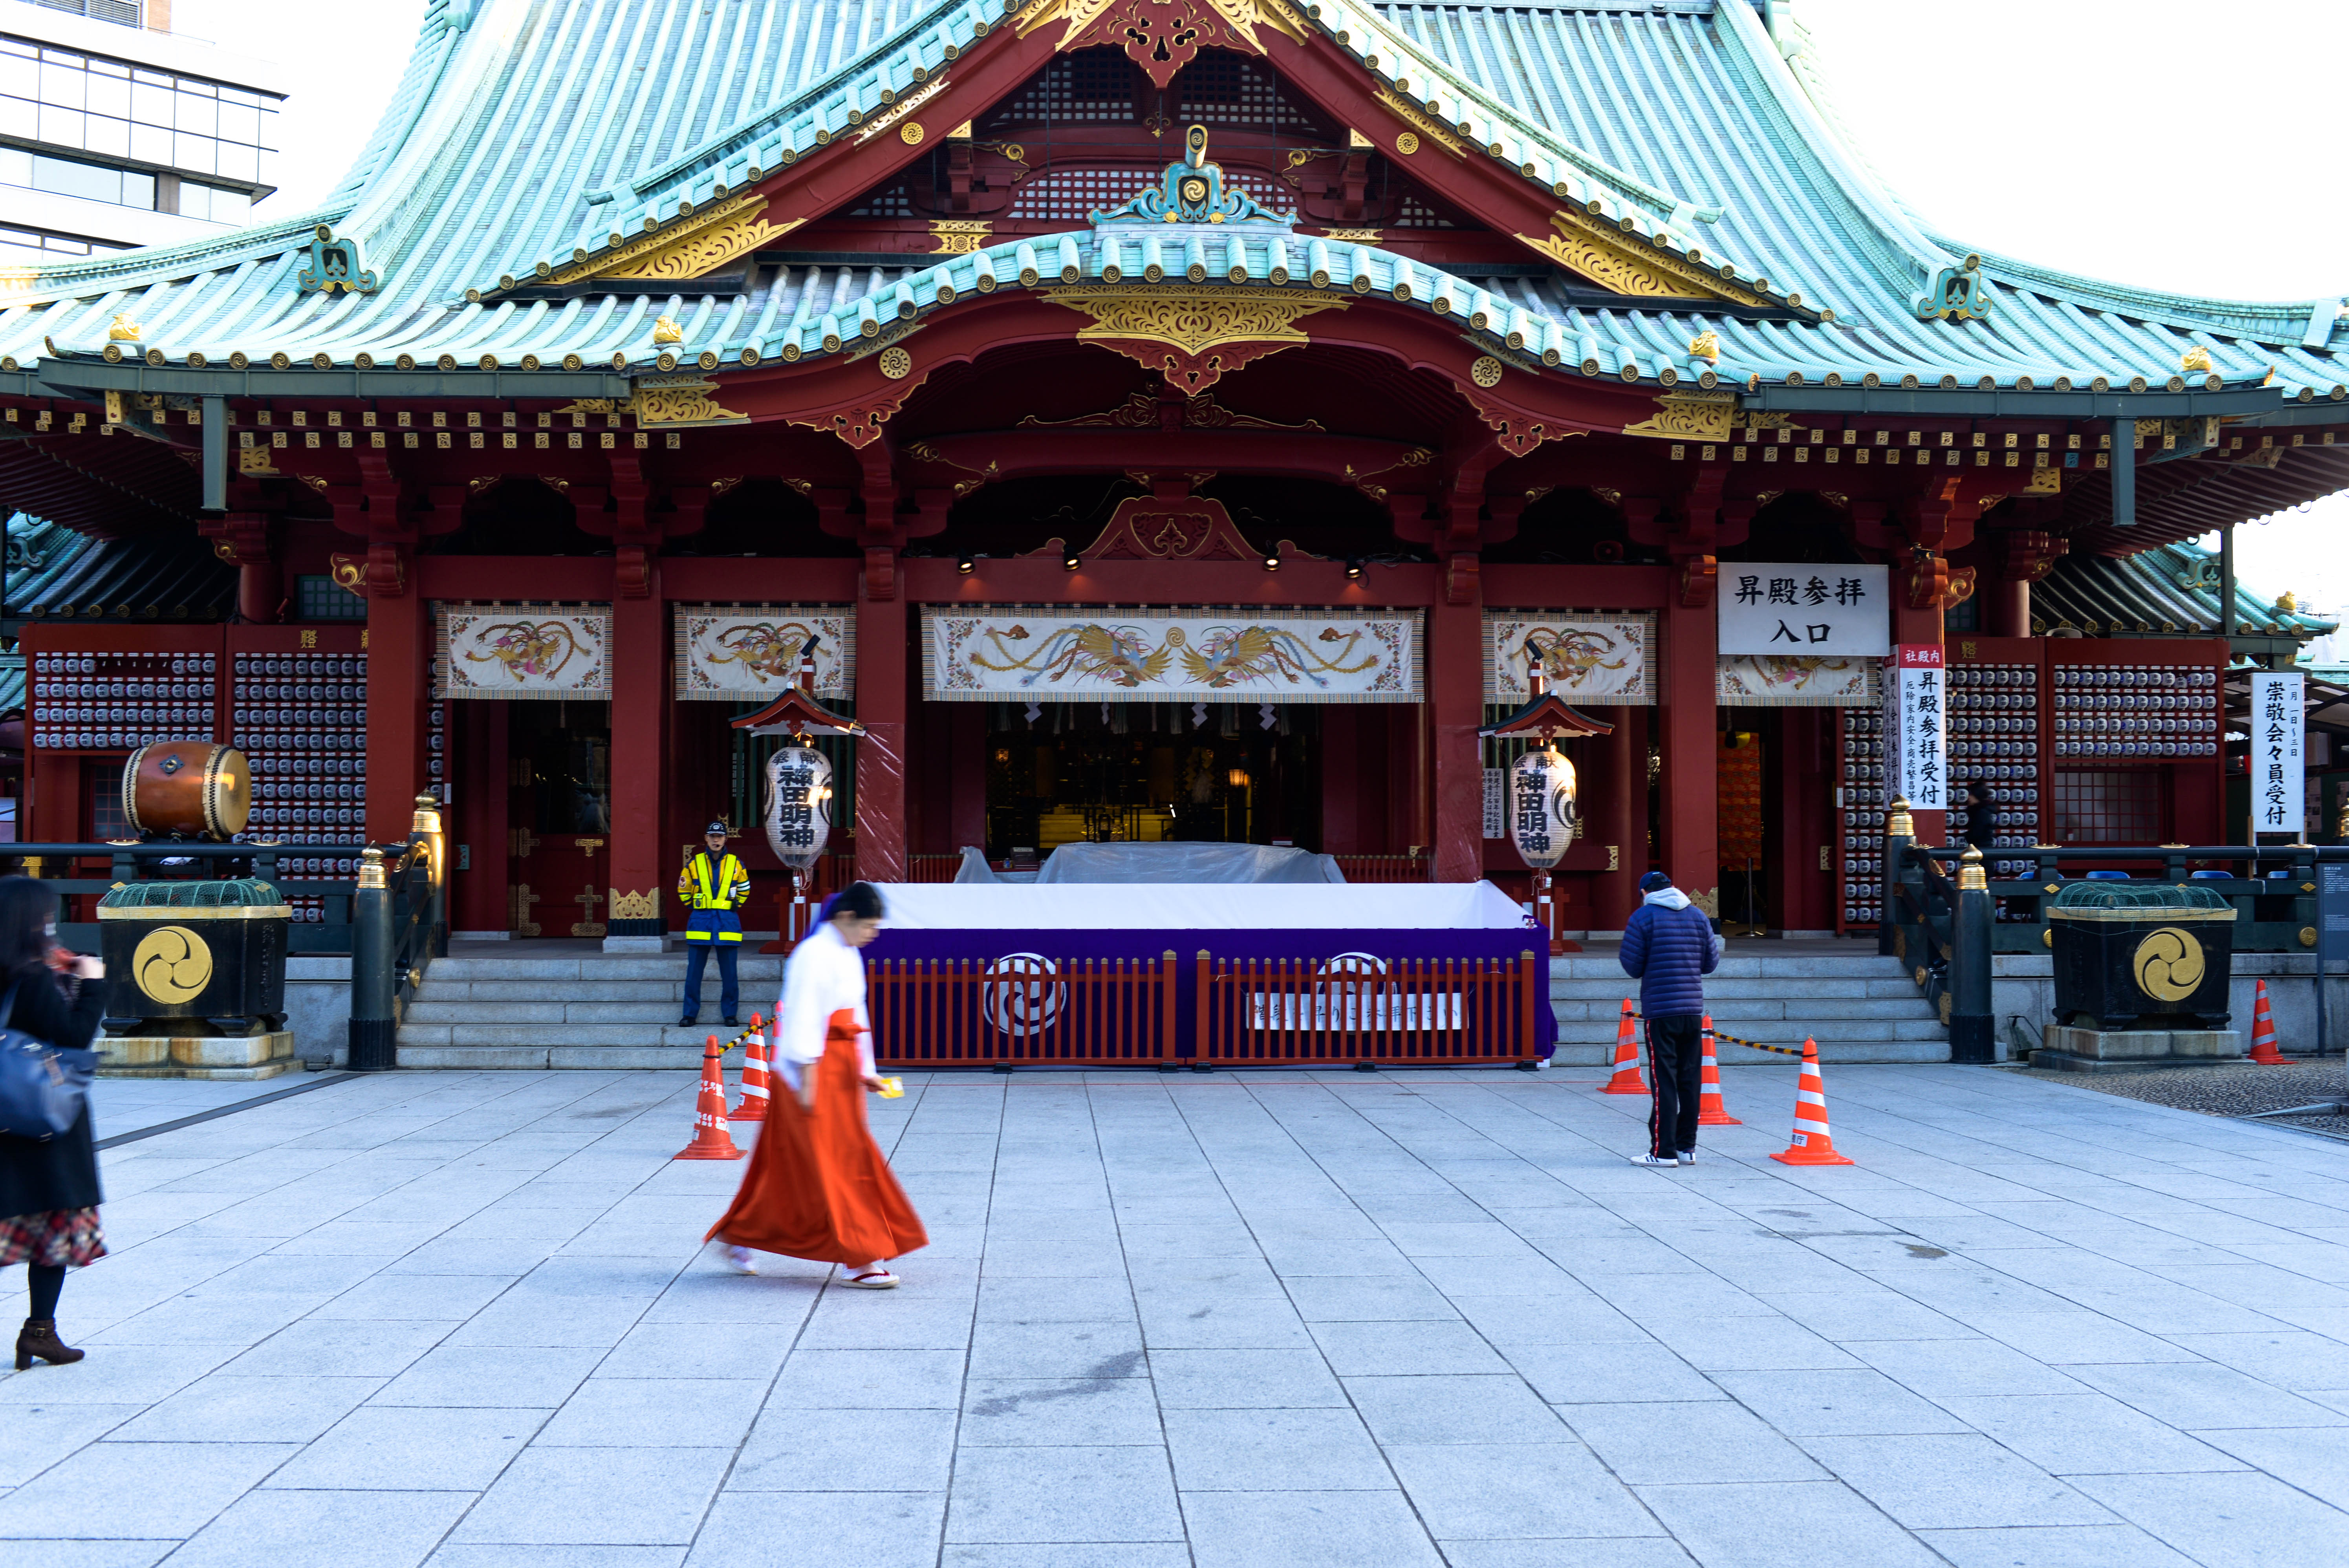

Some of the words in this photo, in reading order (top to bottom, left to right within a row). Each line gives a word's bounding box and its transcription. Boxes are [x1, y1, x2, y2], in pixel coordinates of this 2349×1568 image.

[1735, 575, 1866, 606] 昇殿参拝
[1769, 619, 1831, 644] 入口
[1905, 650, 1940, 663] 社殿内
[1917, 671, 1940, 804] 昇殿参拝受付
[2264, 681, 2287, 825] 崇敬会々員受付
[777, 764, 815, 848] 神田明神
[1516, 769, 1550, 854] 神田明神
